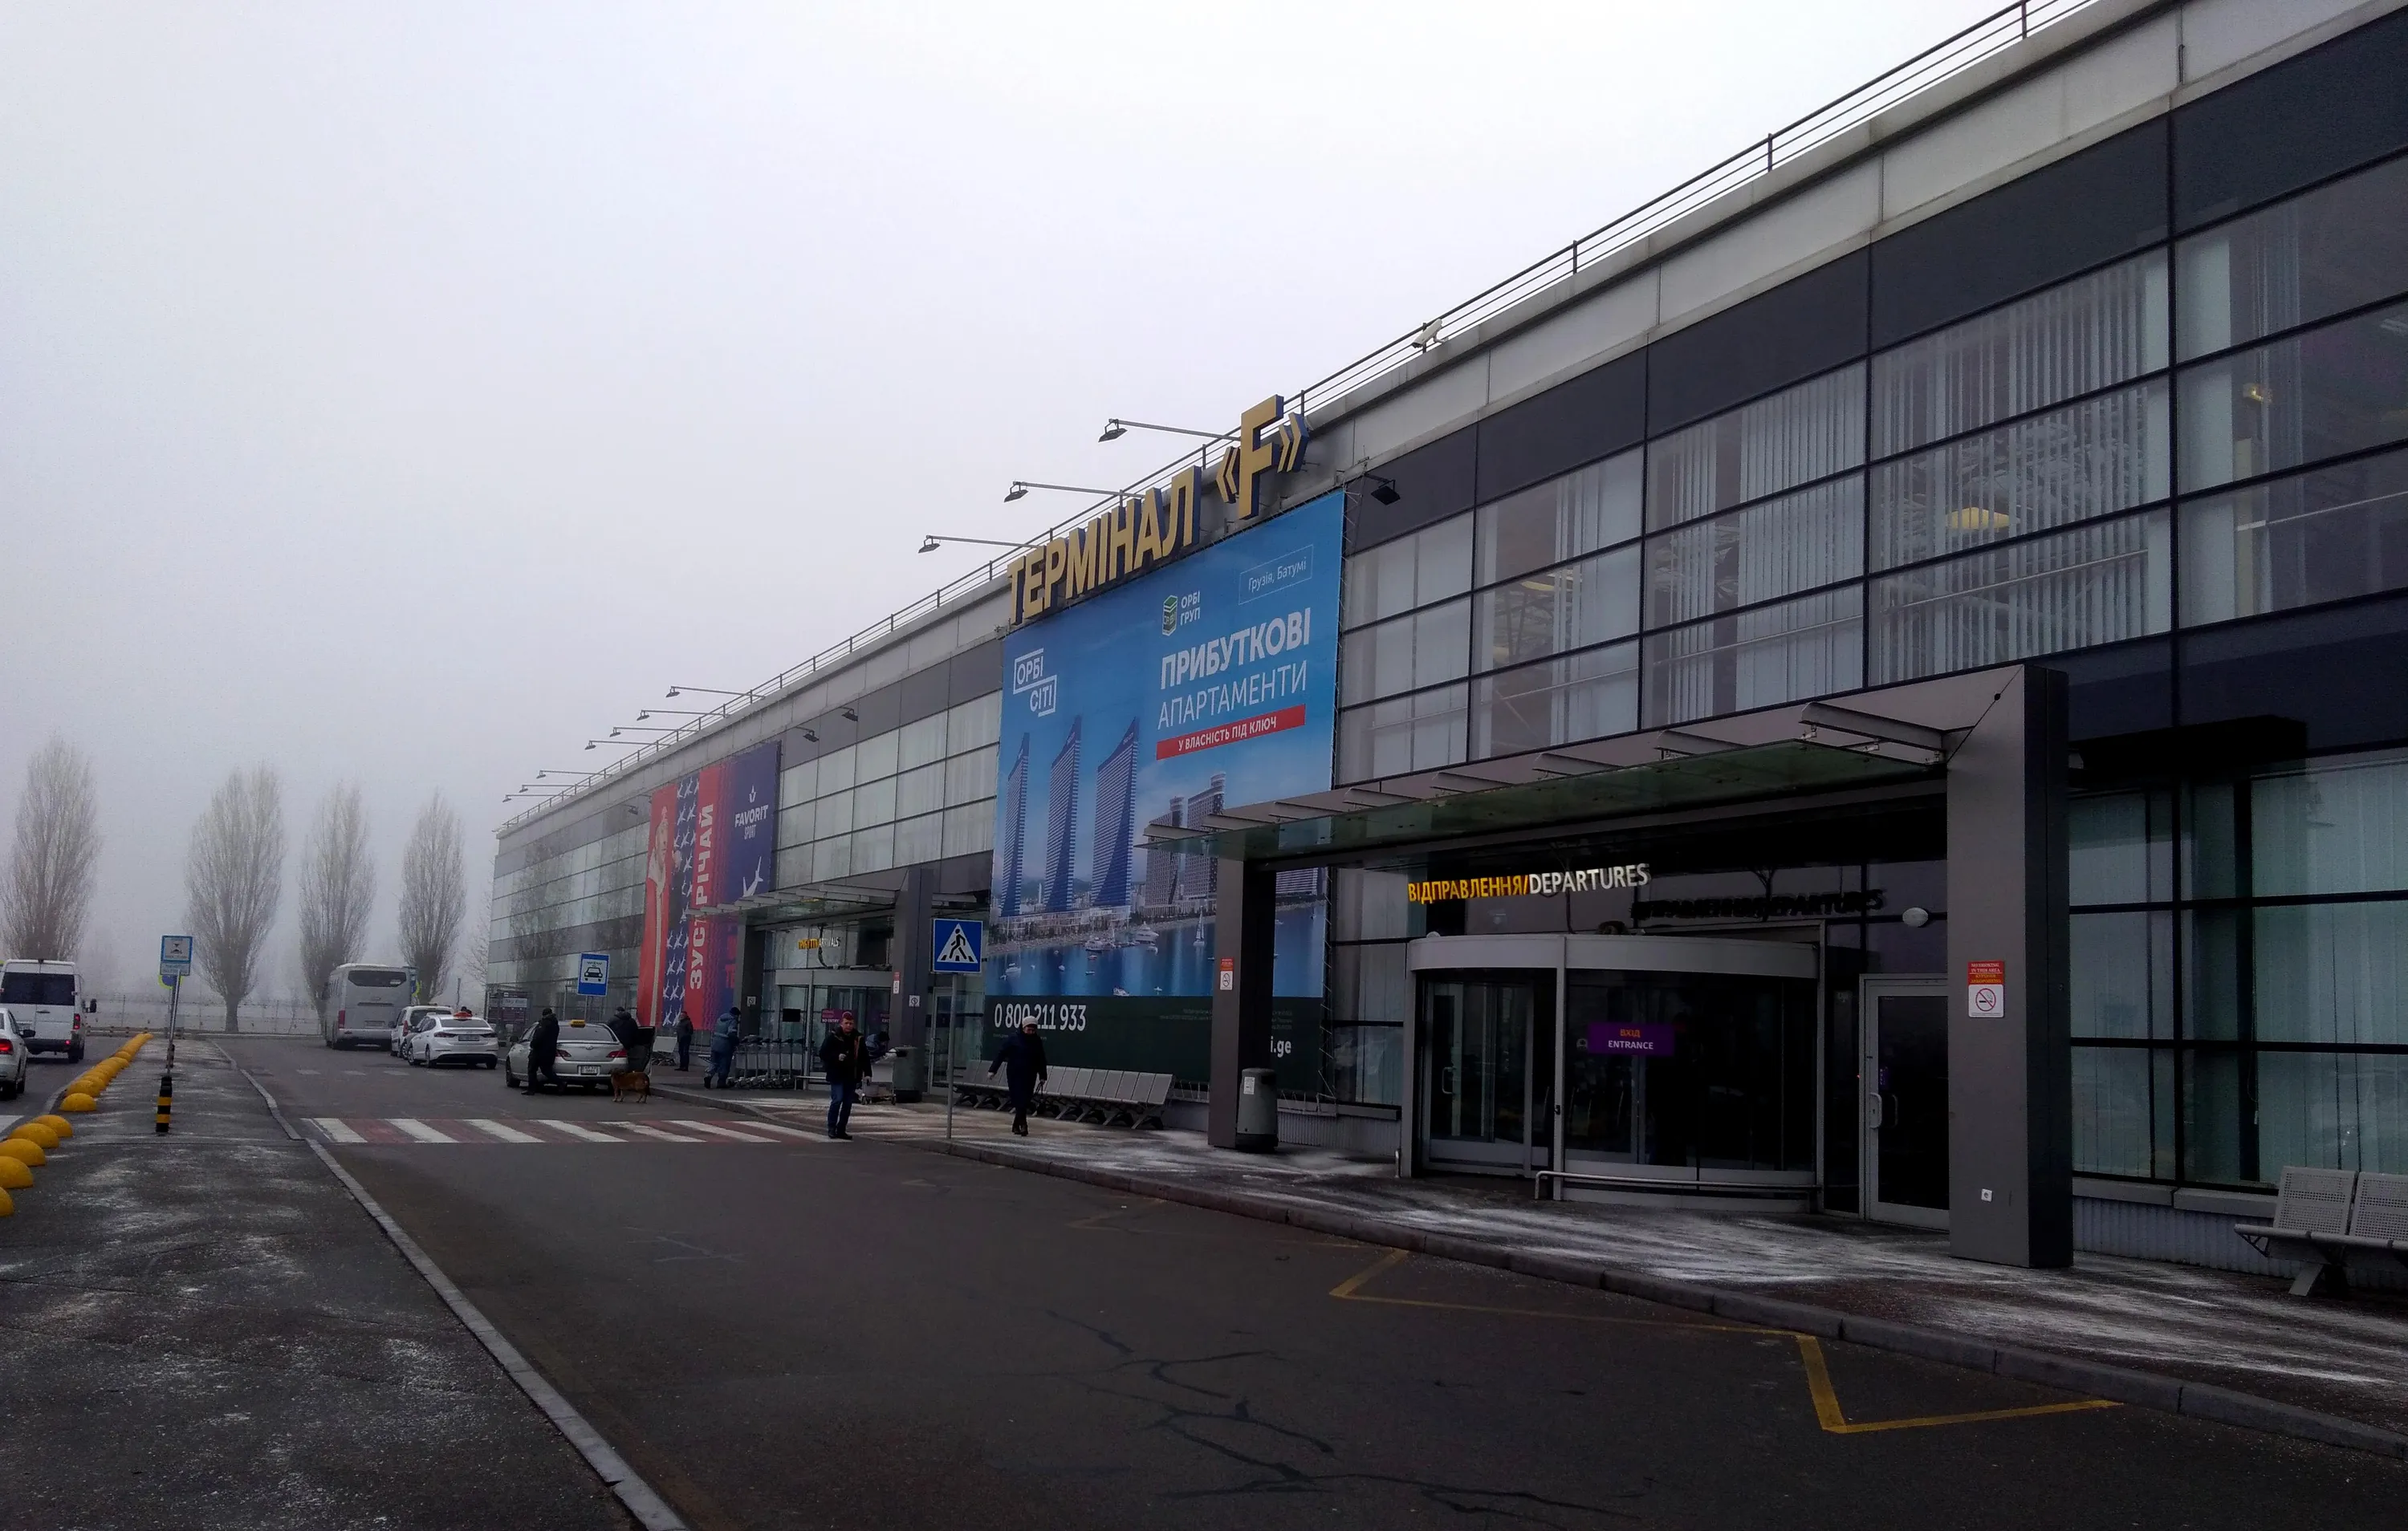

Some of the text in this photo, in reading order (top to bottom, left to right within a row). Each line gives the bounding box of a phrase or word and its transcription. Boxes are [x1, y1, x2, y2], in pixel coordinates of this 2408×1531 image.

[1007, 465, 1202, 625] ТЕРМІНАЛ
[1248, 556, 1307, 593] Грузія, Батумі
[1181, 591, 1200, 608] ОРБІ
[1180, 607, 1200, 626] ГРУП
[1161, 607, 1310, 690] ПРИБУТКОВІ
[1017, 656, 1043, 684] ОРБІ
[1030, 684, 1052, 712] СІТІ
[1157, 660, 1307, 730] АПАРТАМЕНТИ
[1178, 716, 1277, 751] У ВЛАСНІСТЬ ПІД КЛЮЧ
[735, 804, 768, 827] FAVORIT
[994, 1003, 1003, 1028] 0
[1034, 1004, 1056, 1029] 211
[1060, 1004, 1087, 1031] 933
[1608, 1040, 1653, 1050] ENTRANCE
